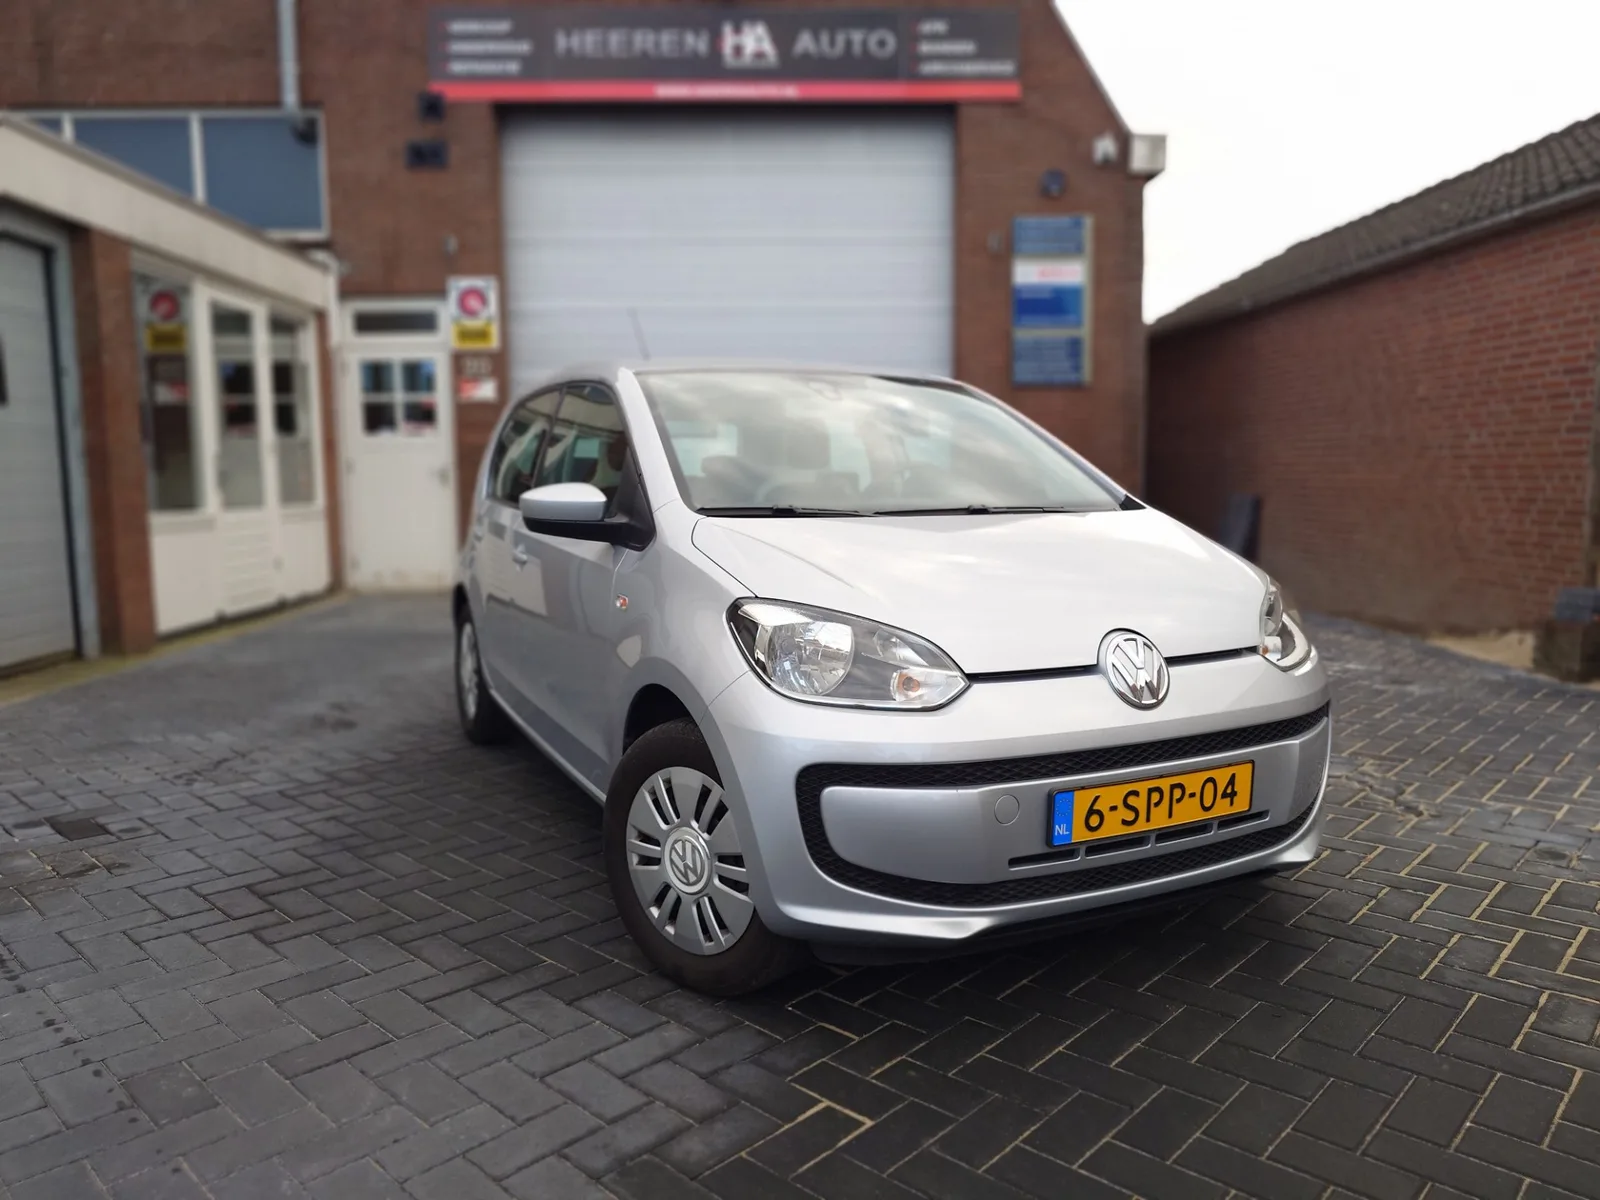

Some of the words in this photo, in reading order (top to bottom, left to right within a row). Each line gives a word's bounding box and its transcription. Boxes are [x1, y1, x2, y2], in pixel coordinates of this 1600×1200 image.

[554, 28, 709, 58] HEEREN
[792, 28, 897, 58] AUTO
[1084, 772, 1238, 833] 6-SPP-04
[1054, 823, 1070, 836] NL
